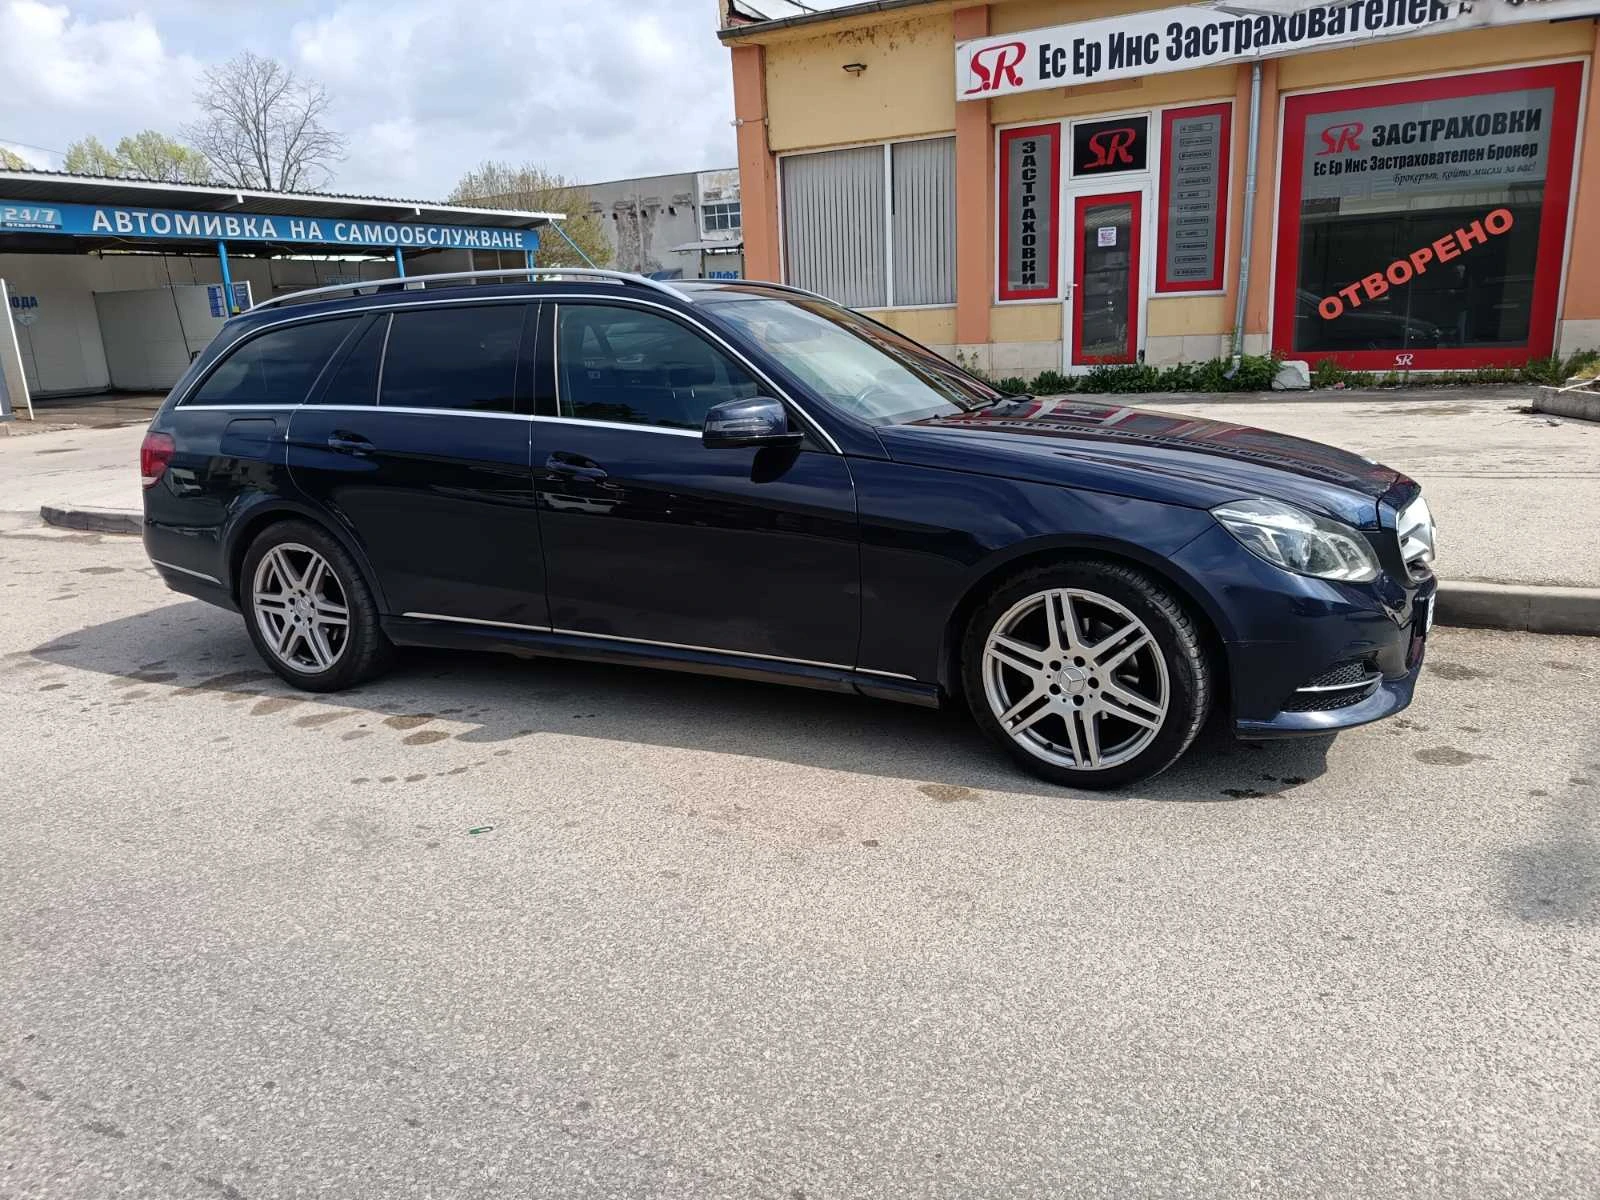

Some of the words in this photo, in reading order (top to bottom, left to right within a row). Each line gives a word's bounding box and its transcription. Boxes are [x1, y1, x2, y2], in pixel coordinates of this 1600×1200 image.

[1039, 43, 1067, 80] Ес
[1072, 37, 1102, 78] Ер
[1107, 31, 1160, 71] Инс
[1166, 0, 1449, 62] Застрахователен
[1371, 108, 1542, 148] ЗАСТРАХОВКИ
[1313, 161, 1327, 177] Ес
[1329, 160, 1343, 176] Ер
[1344, 158, 1368, 174] Инс
[1370, 147, 1485, 171] Застрахователен
[1487, 143, 1538, 161] Брокер
[4, 207, 55, 222] 24/7
[92, 209, 278, 238] АВТОМИВКА
[290, 220, 323, 240] НА
[334, 223, 524, 248] САМООБСЛУЖВАНЕ
[1021, 141, 1037, 285] ЗАСТРАХОВКИ
[1318, 208, 1514, 320] ОТВОРЕНО
[8, 296, 38, 309] ОДА
